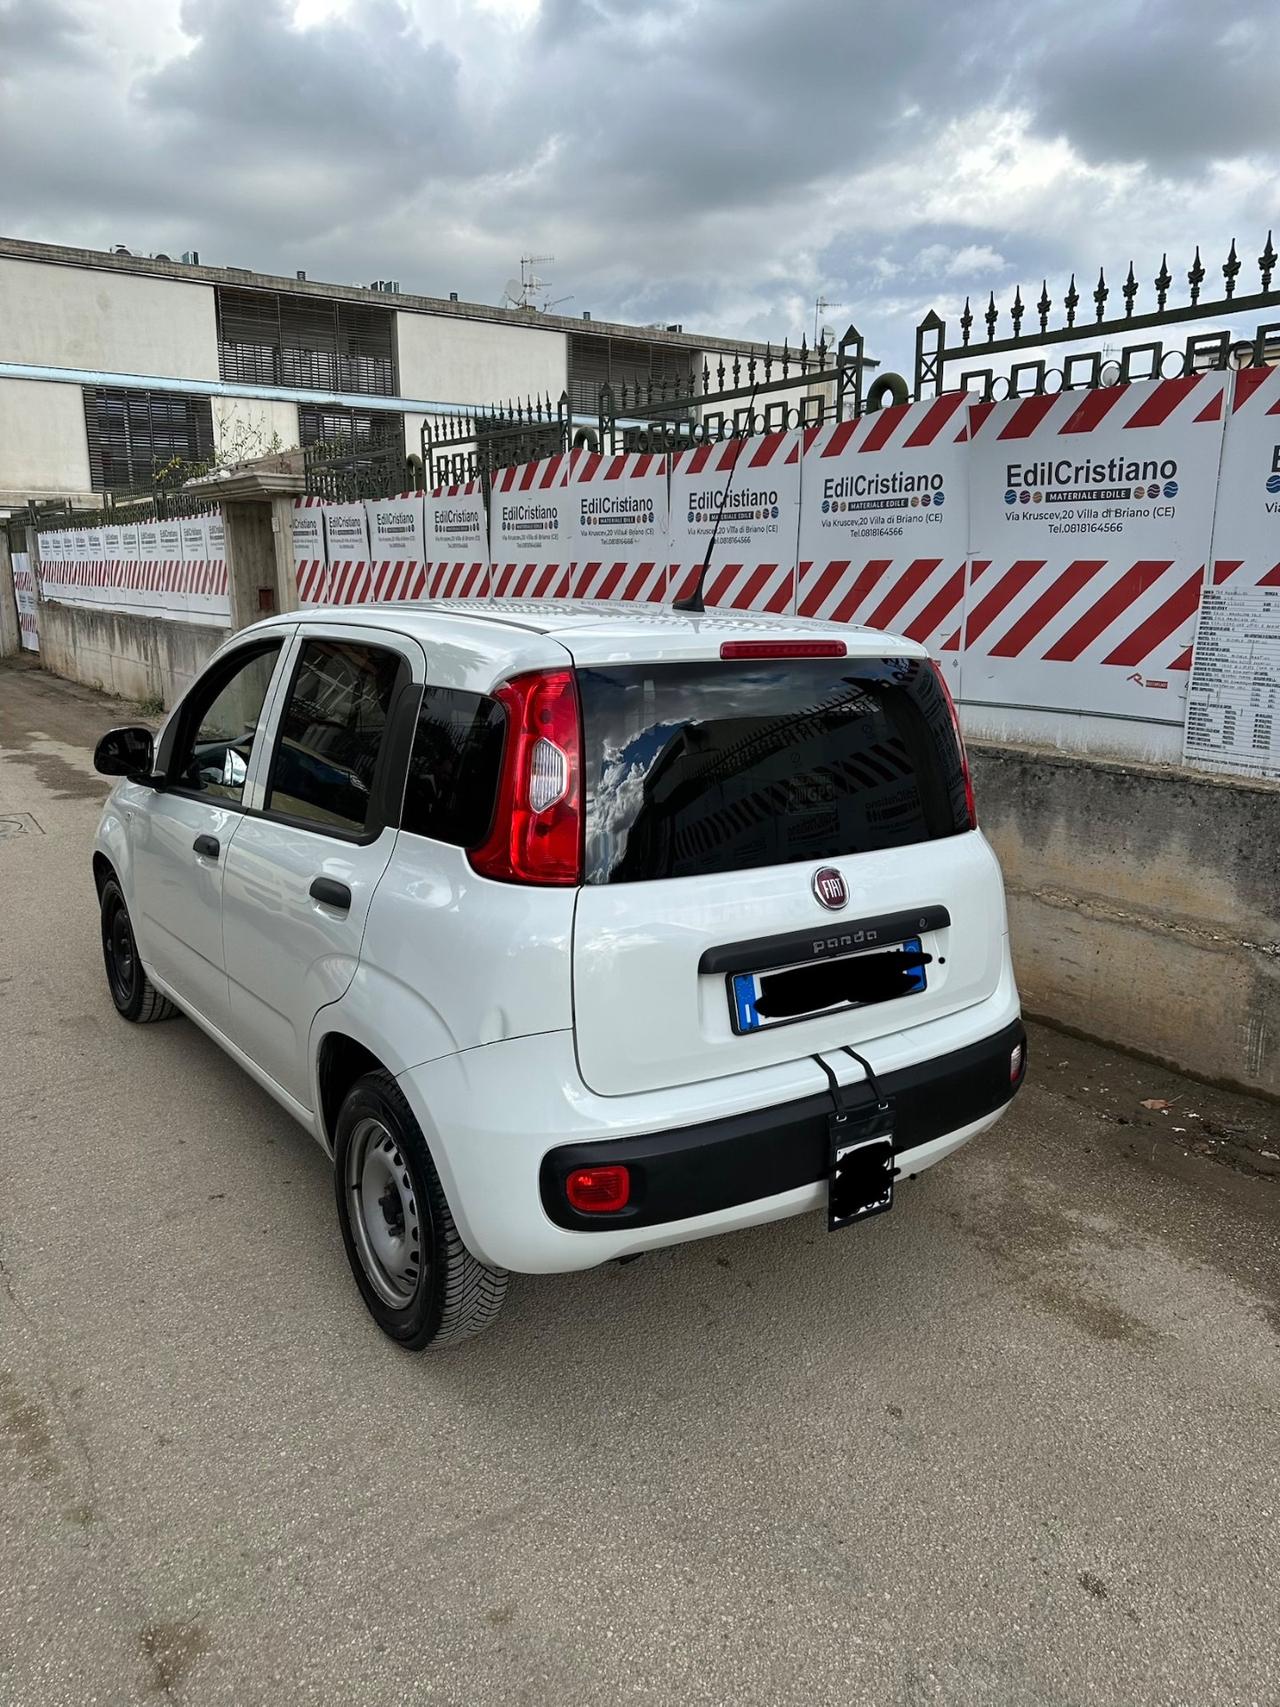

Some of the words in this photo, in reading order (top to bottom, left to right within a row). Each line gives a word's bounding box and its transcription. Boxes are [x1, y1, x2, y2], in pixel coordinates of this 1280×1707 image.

[1007, 457, 1178, 488] EdilCristiano
[823, 471, 944, 499] EdilCristiano
[1049, 490, 1098, 501] MATERIALE
[1100, 489, 1127, 499] EDILE
[581, 496, 653, 514] EdilCristiano
[850, 500, 884, 510] MATERIALE
[885, 499, 905, 508] EDILE
[502, 505, 558, 520] EdilCristiano
[821, 519, 832, 527] Via
[832, 517, 869, 527] Kruscev,20
[869, 516, 885, 525] Villa
[886, 515, 895, 524] di
[896, 514, 924, 524] Briano
[925, 512, 943, 524] (CE)
[1005, 511, 1020, 521] Via
[1022, 508, 1074, 521] Kruscev,20
[1077, 509, 1099, 519] Villa
[1101, 507, 1112, 518] di
[1114, 506, 1150, 518] Briano
[1152, 506, 1176, 519] (CE)
[1048, 522, 1123, 534] Tel.0818164566
[821, 878, 845, 899] FIAT
[812, 930, 878, 953] panda
